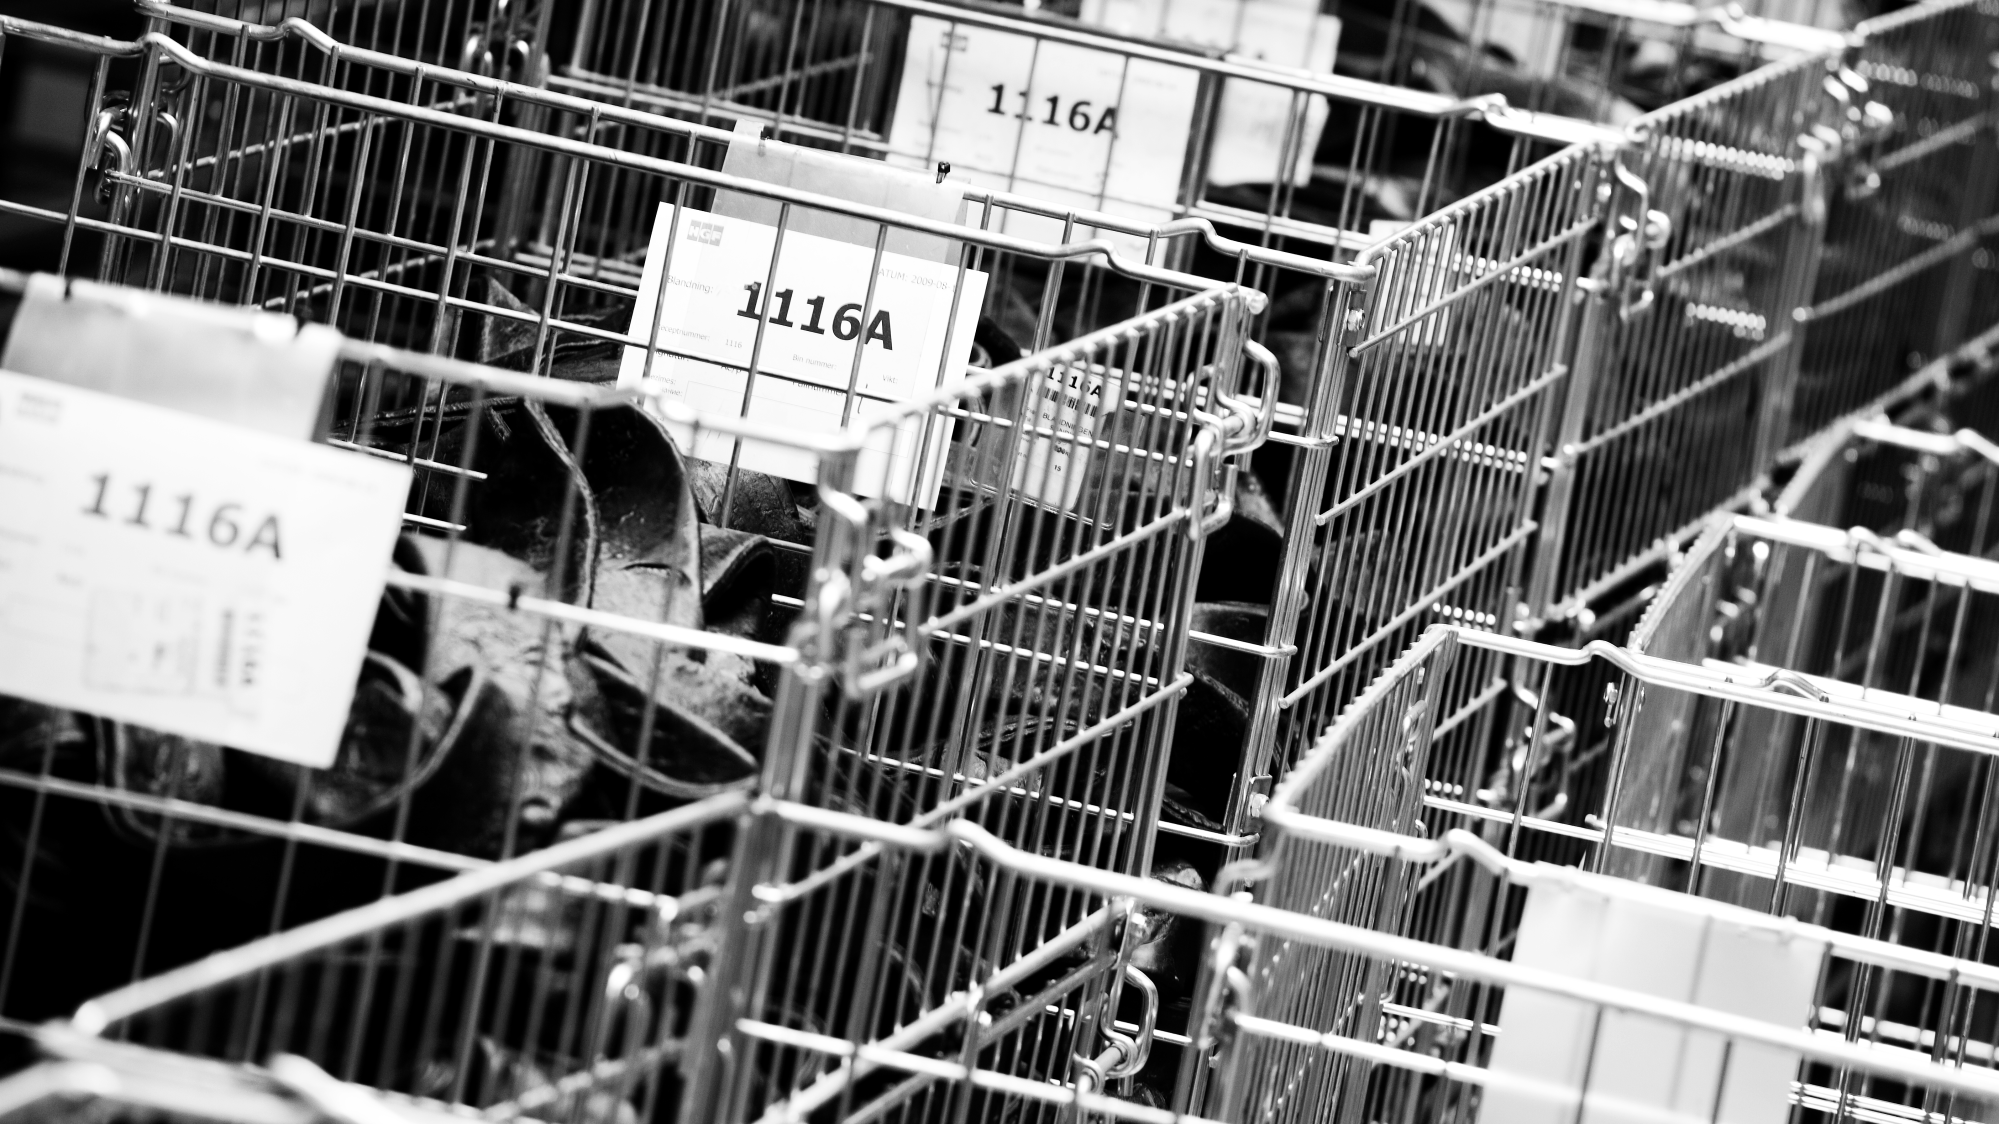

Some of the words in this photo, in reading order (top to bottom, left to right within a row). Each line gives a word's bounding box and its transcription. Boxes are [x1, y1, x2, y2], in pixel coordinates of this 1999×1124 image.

[987, 83, 1119, 140] 1116A
[878, 266, 908, 282] ATUM:
[667, 275, 714, 295] Blandning:
[737, 281, 893, 350] 1116A
[658, 323, 711, 342] eceptnummer:
[725, 338, 743, 349] 1116
[792, 354, 804, 364] Bin
[806, 357, 837, 370] nummer:
[882, 373, 898, 385] Vikt:
[81, 472, 283, 560] 1116A
